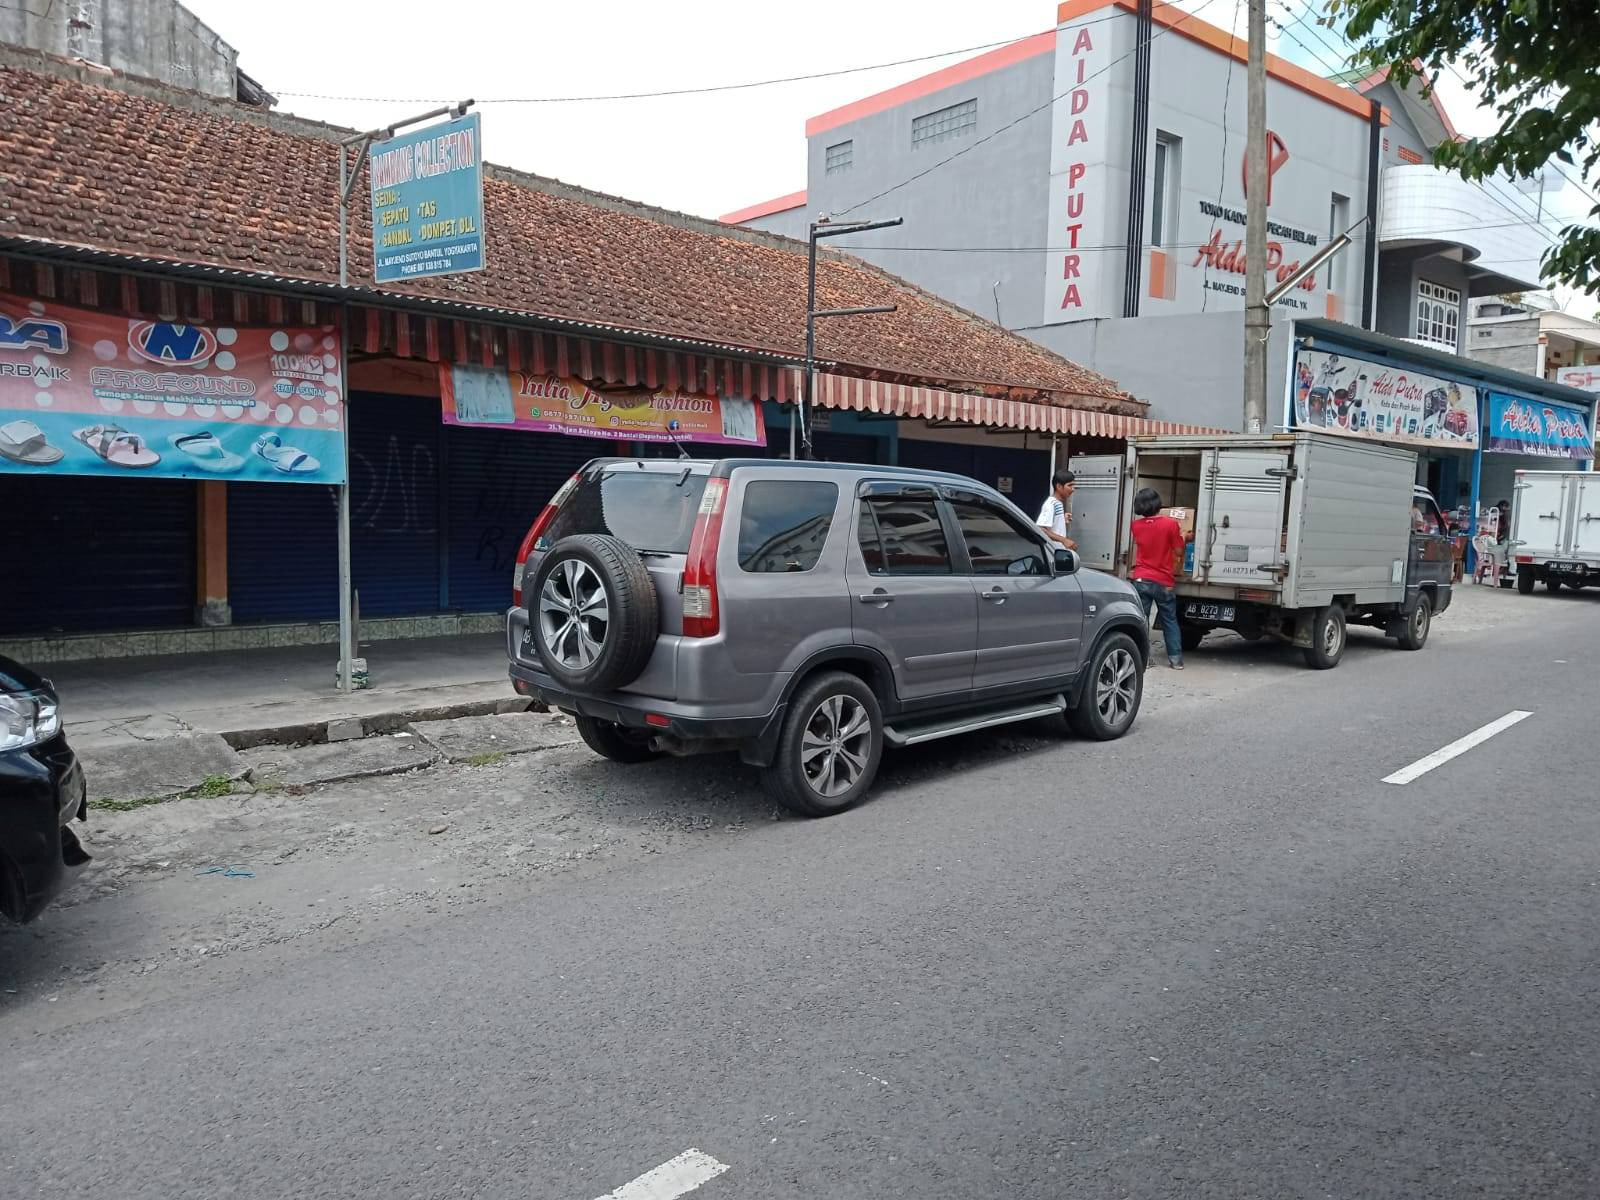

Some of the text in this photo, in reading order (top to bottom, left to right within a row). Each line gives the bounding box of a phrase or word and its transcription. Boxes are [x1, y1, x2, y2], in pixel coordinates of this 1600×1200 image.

[415, 128, 475, 179] COLLECTION
[1061, 27, 1093, 310] AIDA PUTRA
[382, 201, 436, 226] SEPATU TAS
[1199, 201, 1223, 218] TOKO
[1267, 221, 1292, 239] PECAH
[1292, 229, 1317, 246] BELAH
[383, 230, 412, 247] SANDAL
[459, 216, 476, 233] DLL
[405, 252, 425, 263] SUTOYO
[424, 248, 443, 259] BANTUL
[444, 243, 477, 255] YOGYAKARTA
[401, 263, 417, 274] PHONE
[1212, 281, 1240, 295] MAYJEND
[90, 366, 256, 396] PROFOUND
[94, 388, 132, 400] Semoga
[133, 391, 164, 402] Semua
[273, 383, 295, 394] SEPATU
[301, 386, 326, 397] SANDAL
[518, 374, 571, 401] Yulia
[648, 390, 713, 414] Fashion
[1369, 369, 1423, 401] Aida Putra
[1501, 400, 1542, 435] Aida
[1187, 604, 1197, 614] AB
[1200, 604, 1218, 615] 8273
[1224, 607, 1235, 617] HS
